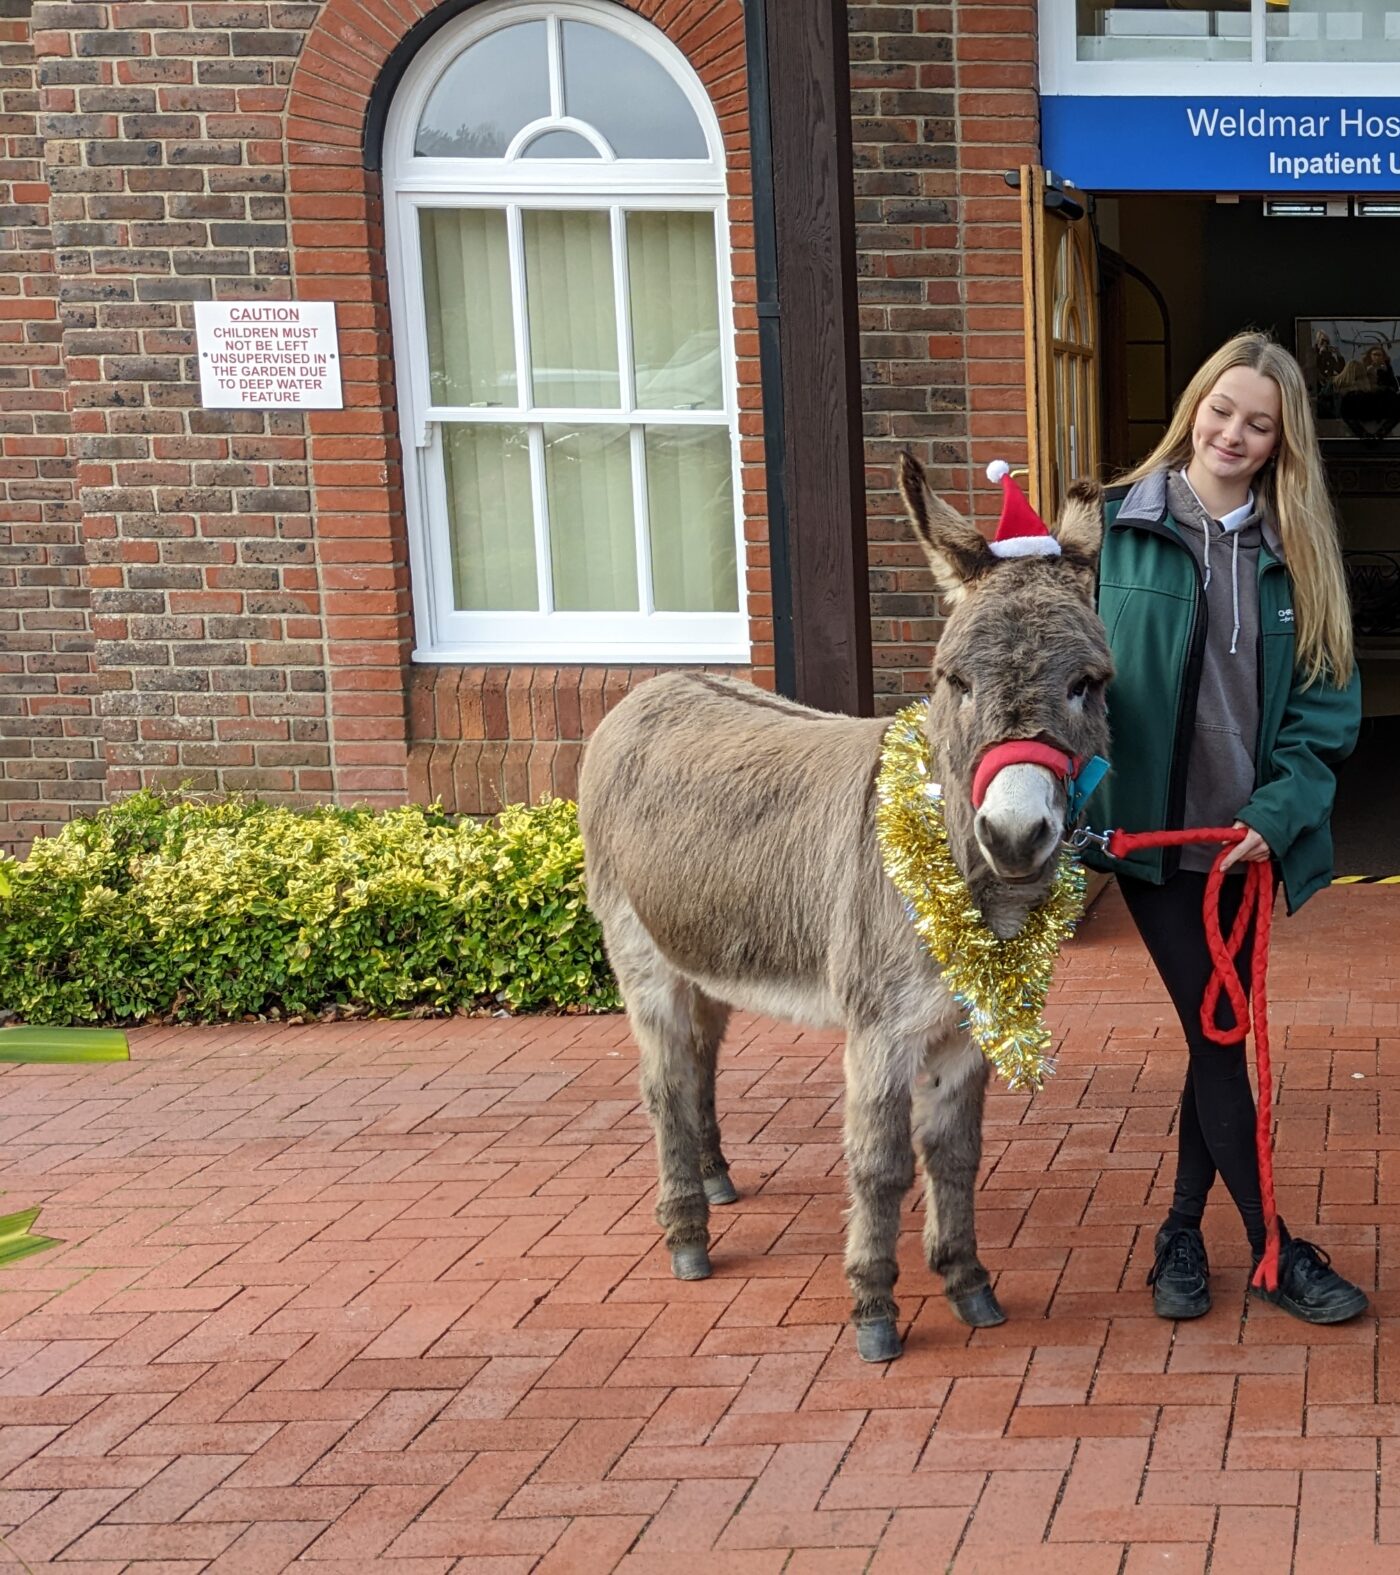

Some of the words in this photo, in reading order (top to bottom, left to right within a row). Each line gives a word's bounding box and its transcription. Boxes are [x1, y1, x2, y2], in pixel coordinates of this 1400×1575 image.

[1186, 108, 1330, 137] Weldmar
[1269, 152, 1381, 179] Inpatient
[230, 308, 300, 320] CAUTION
[213, 328, 278, 338] CHILDREN
[282, 328, 318, 338] MUST
[226, 340, 252, 351] NOT
[256, 340, 273, 351] BE
[276, 340, 308, 351] LEFT
[210, 353, 310, 364] UNSUPERVISED
[314, 354, 326, 364] IN
[212, 366, 238, 376] THE
[241, 366, 296, 376] GARDEN
[300, 366, 327, 376] DUE
[218, 379, 236, 389] TO
[240, 379, 273, 389] DEEP
[277, 379, 322, 390] WATER
[242, 392, 301, 402] FEATURE
